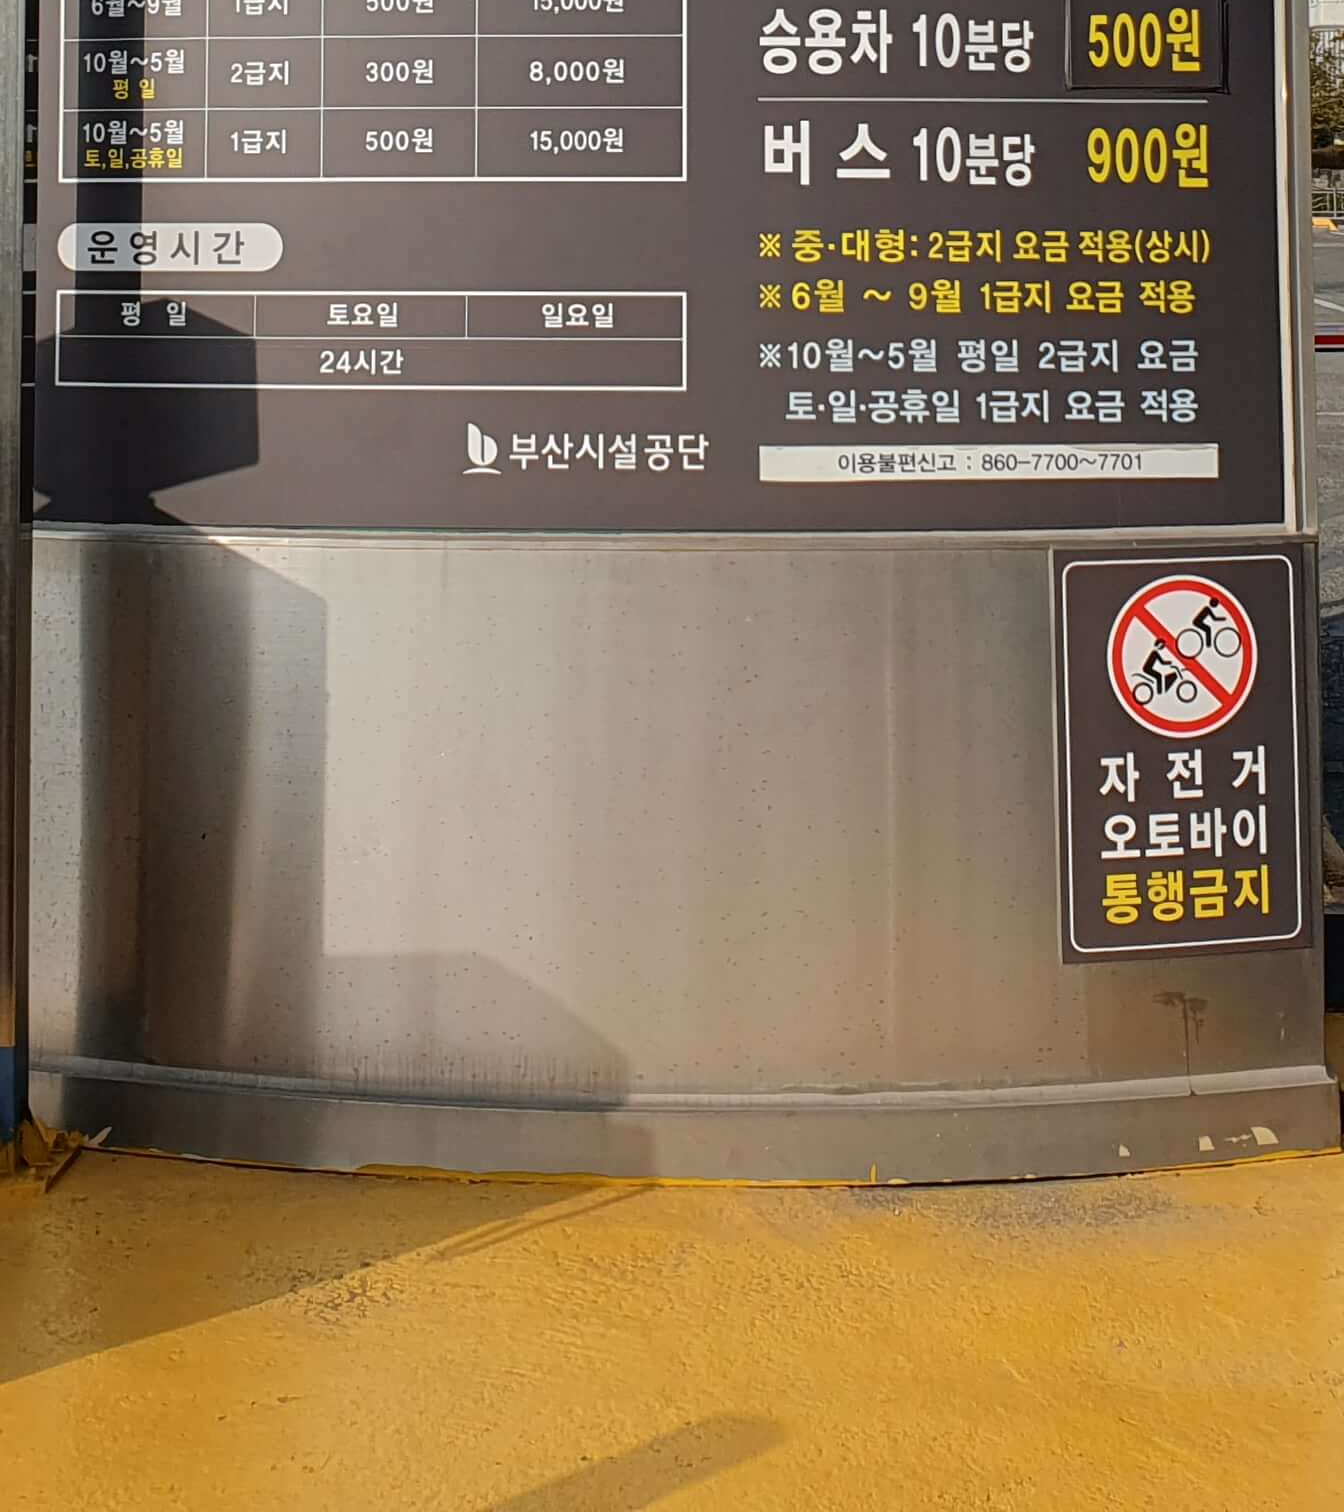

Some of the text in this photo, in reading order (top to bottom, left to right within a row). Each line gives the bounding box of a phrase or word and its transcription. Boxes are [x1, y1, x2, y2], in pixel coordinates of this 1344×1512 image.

[760, 8, 1201, 74] 승용차 10분당 500원
[83, 49, 624, 86] 10월~5월 2급지 300원 8,000원
[83, 120, 624, 154] 10월~5월 1급지 500원 15,000원
[913, 127, 1034, 186] 10분당
[1088, 124, 1209, 188] 900원
[87, 231, 246, 266] 운영시간
[928, 230, 1001, 262] 2급지
[1013, 231, 1069, 262] 요금
[1079, 230, 1210, 264] 적용(상시)
[792, 279, 844, 312] 6월
[909, 280, 961, 313] 9월
[981, 280, 1051, 313] 1급지
[1067, 282, 1124, 312] 요금
[1140, 280, 1195, 314] 적용
[327, 303, 399, 327] 토요일
[542, 303, 615, 328] 일요일
[320, 350, 404, 374] 24시간
[958, 340, 1018, 373] 평일
[1039, 340, 1119, 372] 2급지
[1138, 341, 1198, 371] 요금
[976, 390, 1050, 423] 1급지
[1065, 391, 1124, 422] 요금
[1141, 389, 1198, 423] 적용
[510, 434, 710, 471] 부산시설공단
[838, 452, 956, 473] 이용불편신고
[1100, 806, 1267, 860] 오토바이
[1102, 865, 1270, 925] 통행금지
